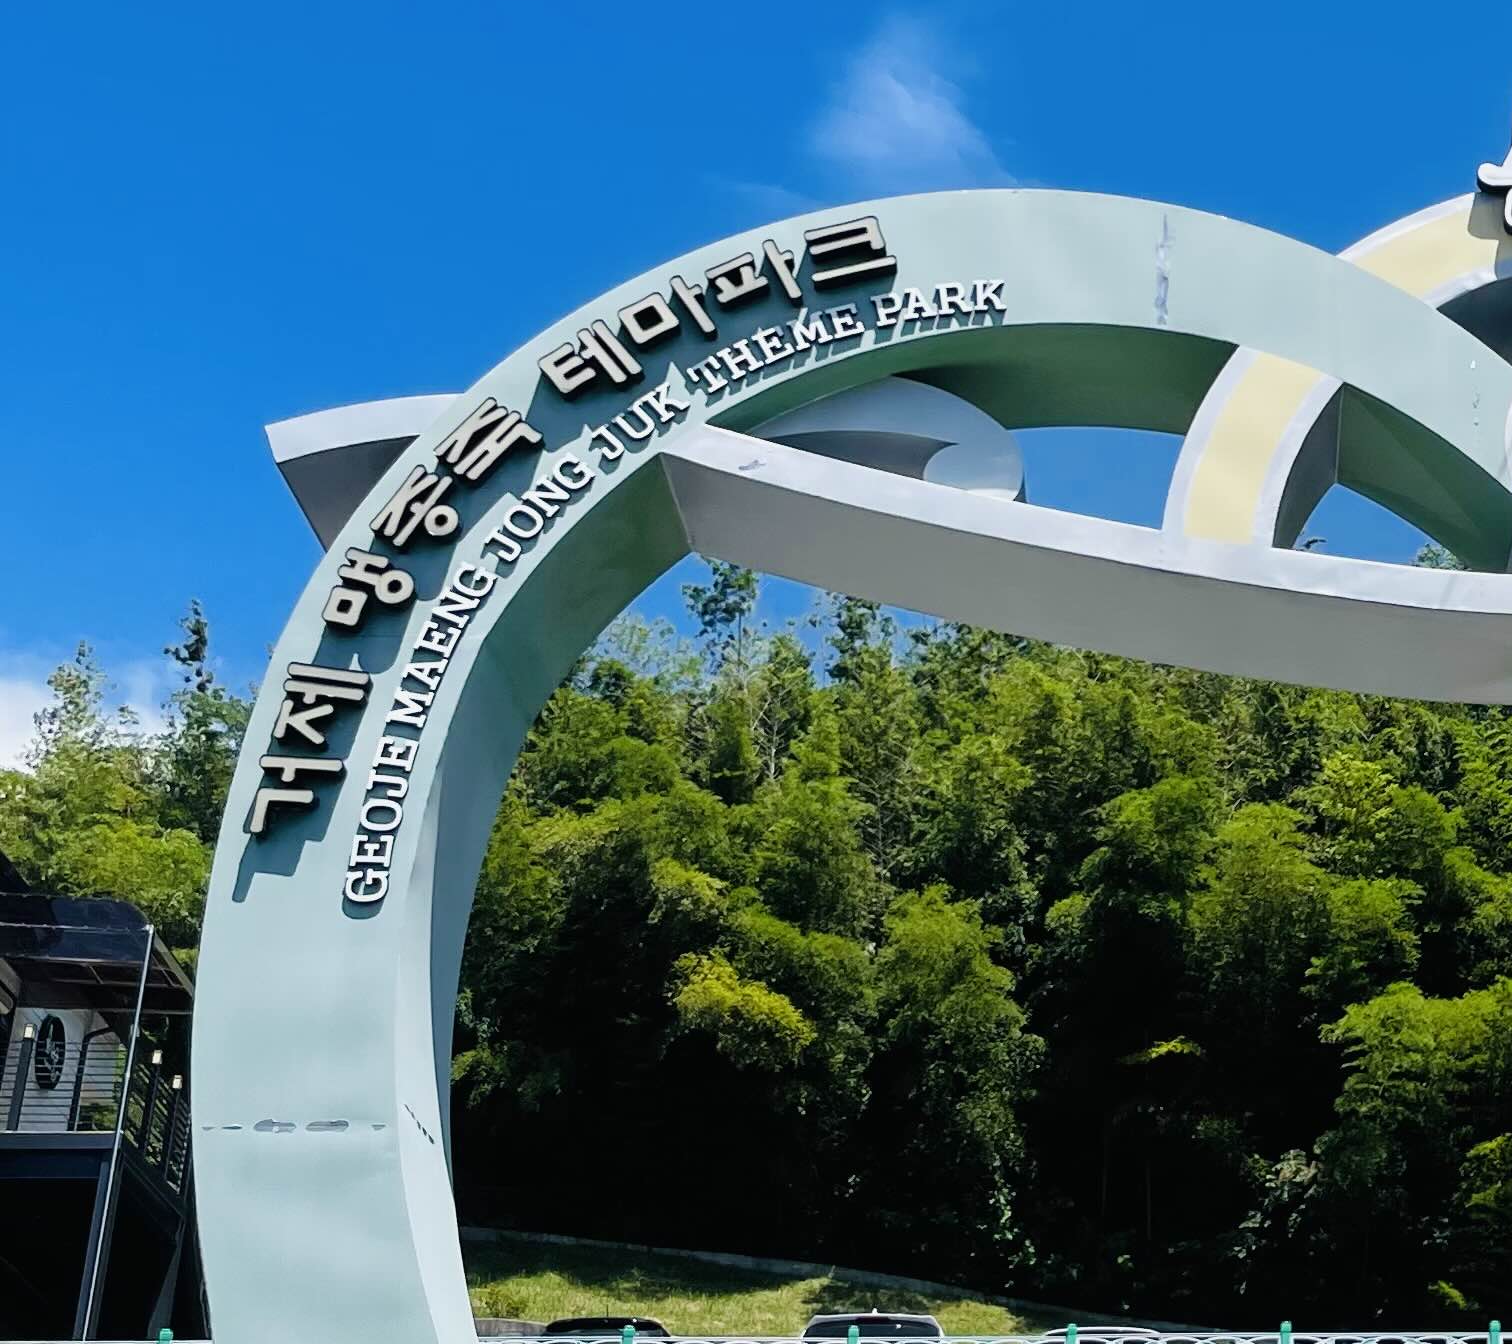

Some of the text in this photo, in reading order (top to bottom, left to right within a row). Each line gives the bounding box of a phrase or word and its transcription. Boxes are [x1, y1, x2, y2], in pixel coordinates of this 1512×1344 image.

[245, 216, 898, 836] 거제 맹종죽 테마파크
[344, 278, 1008, 904] GEOJE MAENG JONG JUK THEME PARK
